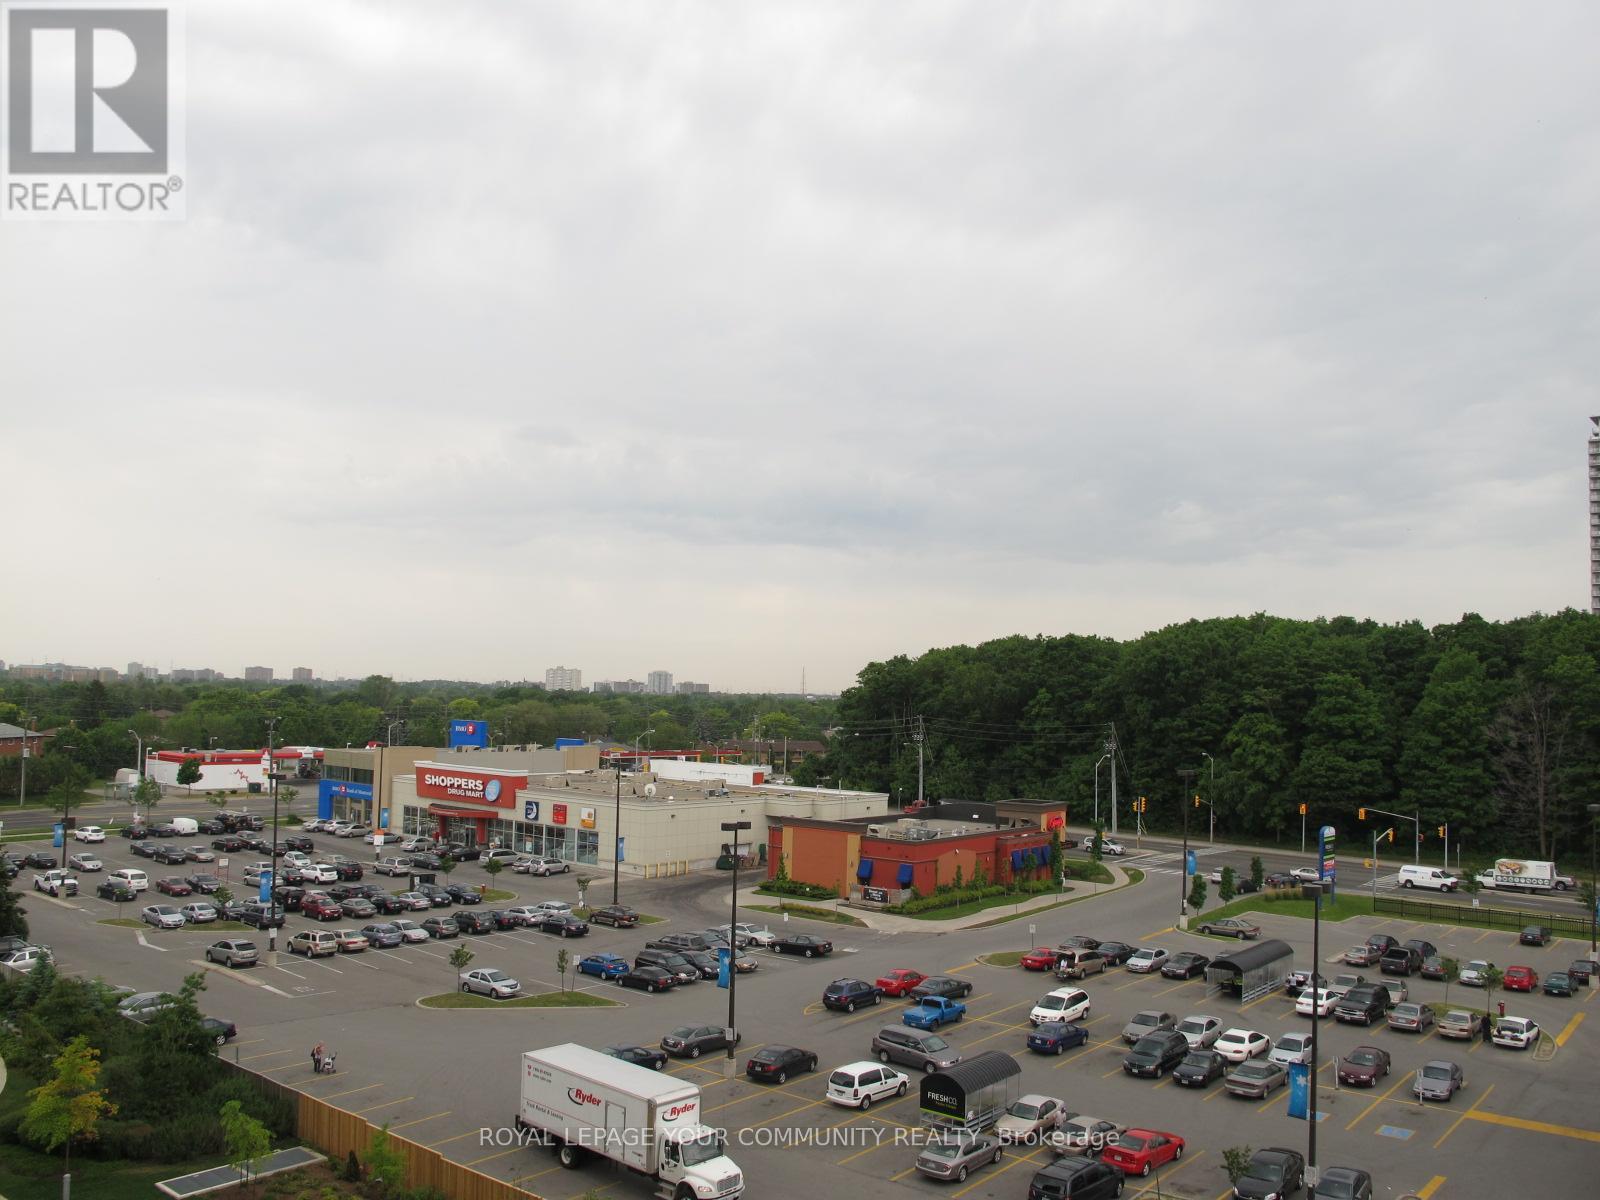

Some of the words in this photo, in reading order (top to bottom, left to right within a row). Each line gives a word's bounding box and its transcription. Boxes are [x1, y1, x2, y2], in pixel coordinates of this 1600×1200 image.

[424, 774, 484, 791] SHOPPERS
[447, 788, 465, 796] DRUG
[465, 790, 484, 798] MART
[575, 1088, 601, 1107] Ryder
[670, 1103, 696, 1116] Ryder
